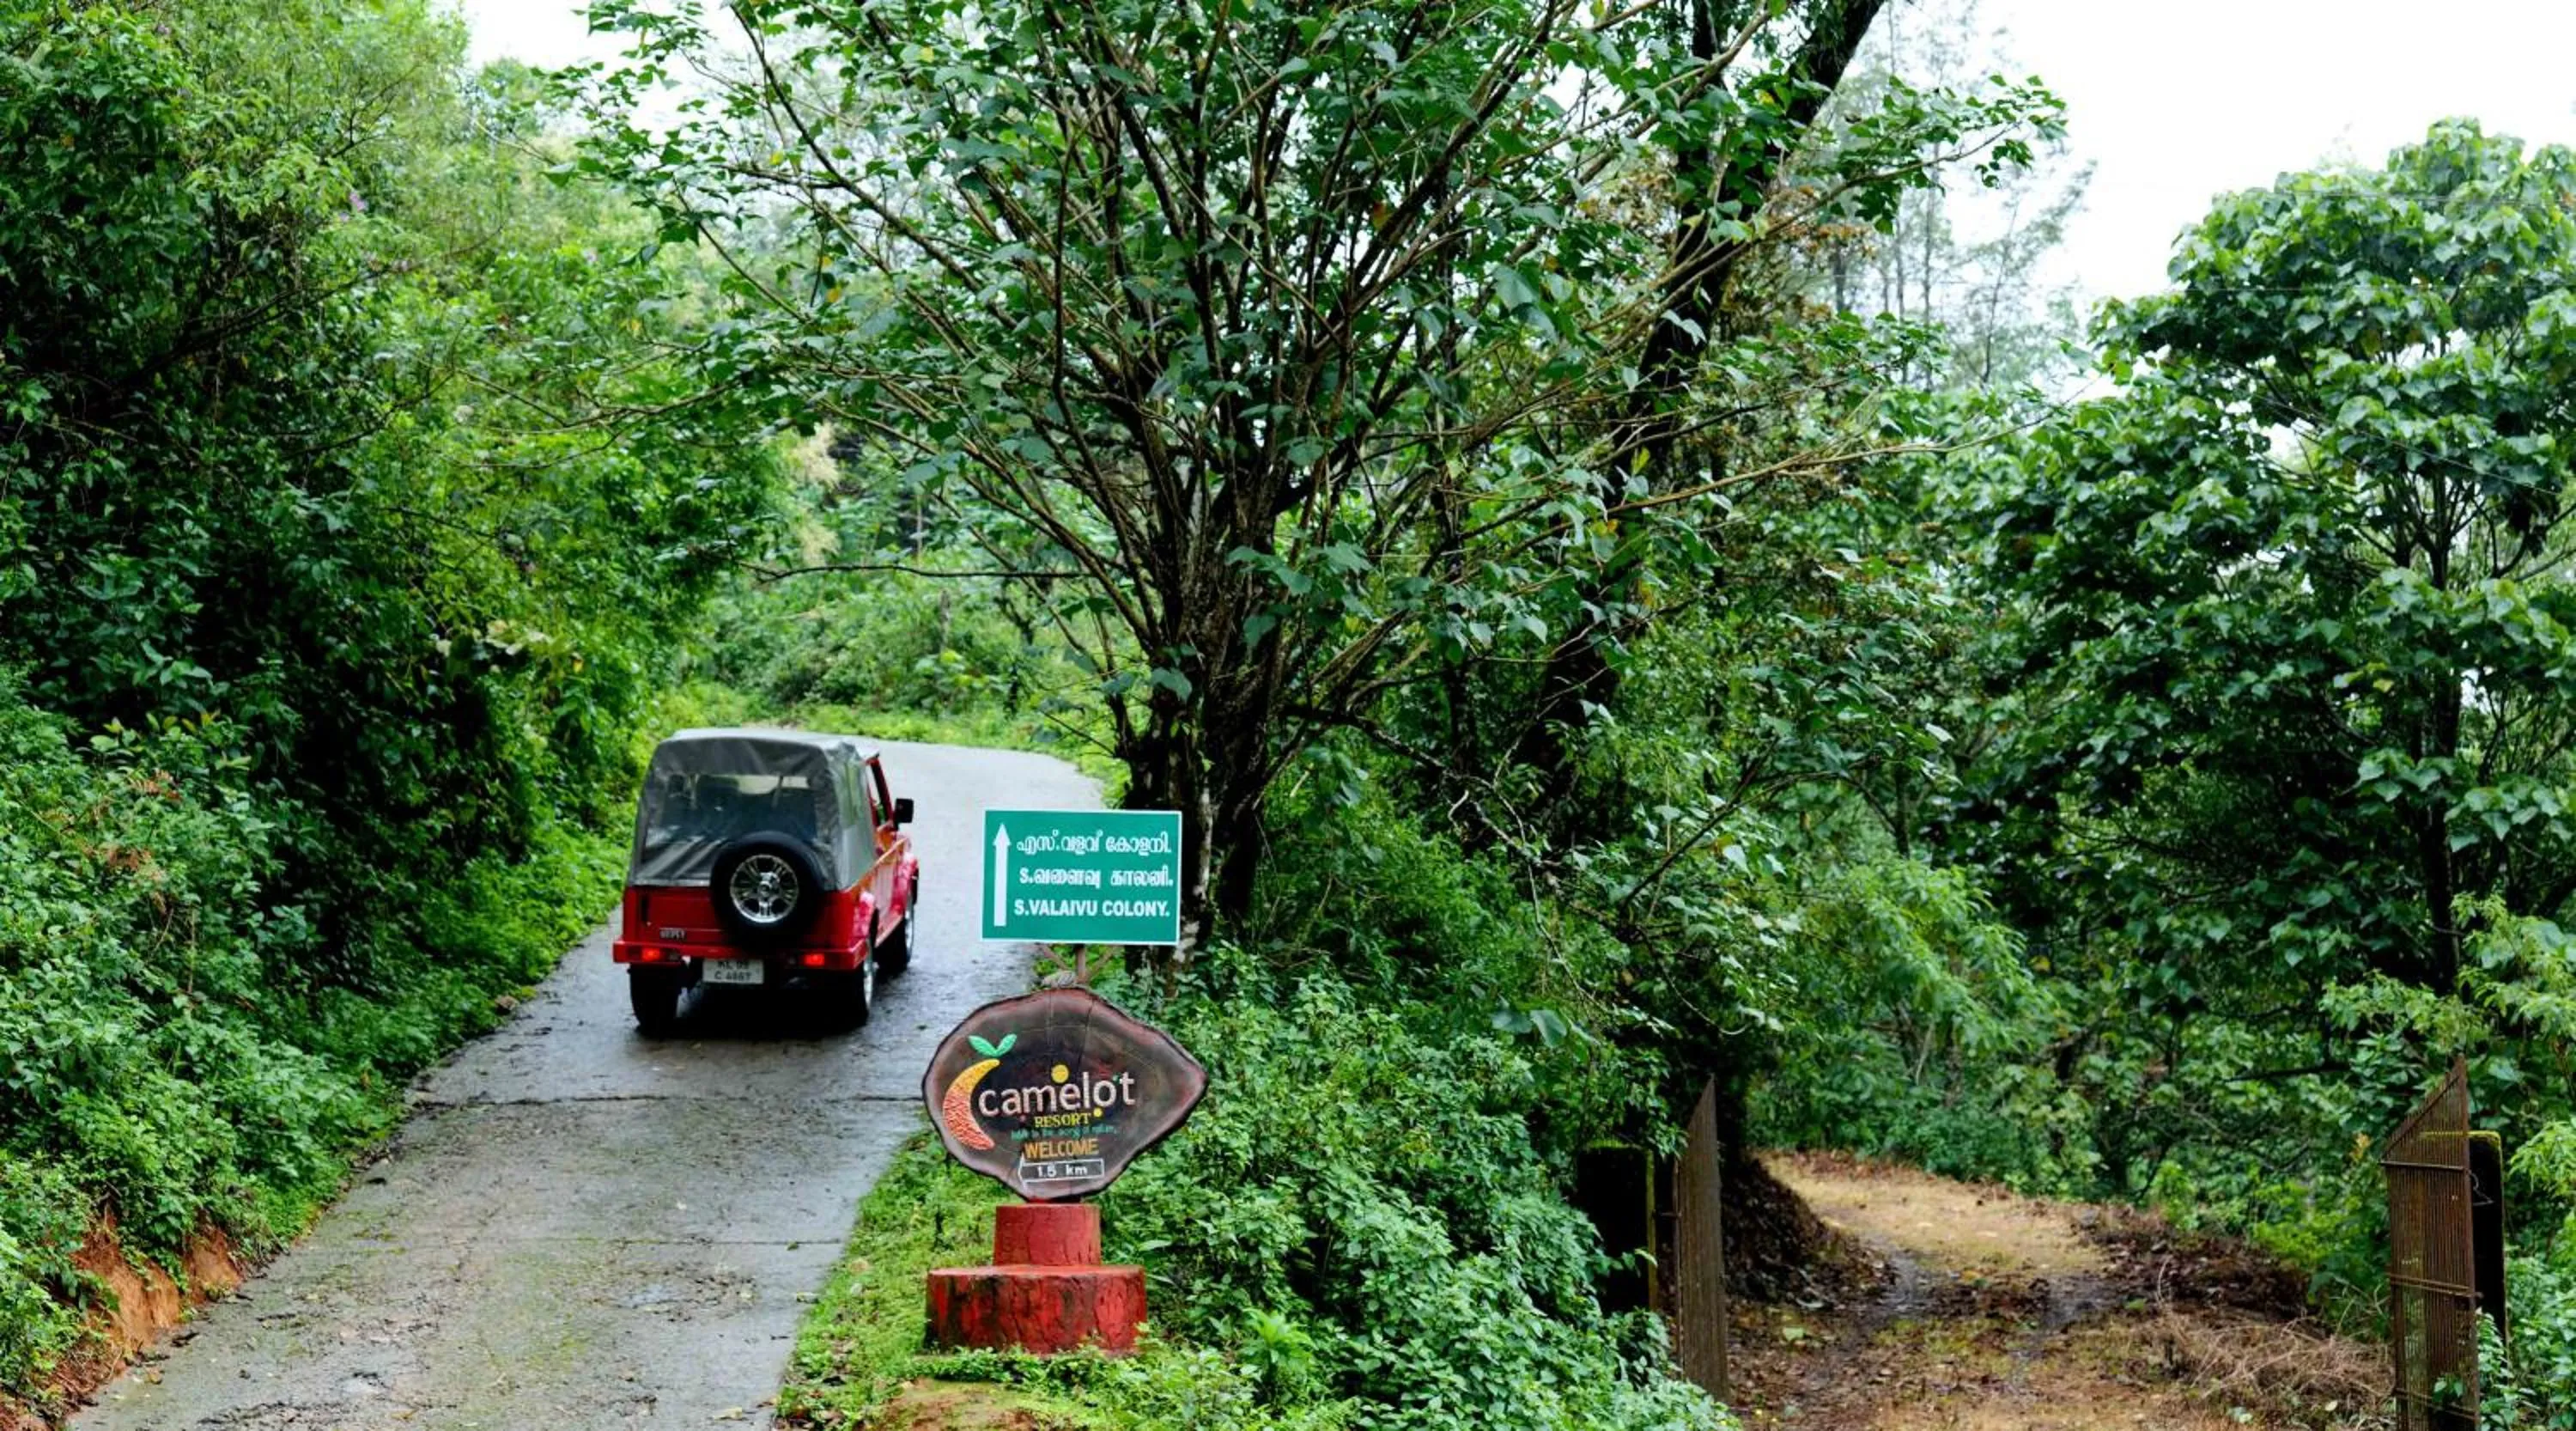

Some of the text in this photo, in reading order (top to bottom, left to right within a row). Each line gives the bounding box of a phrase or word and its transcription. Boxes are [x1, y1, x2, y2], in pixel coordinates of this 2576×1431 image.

[1014, 899, 1170, 917] S.VALAIVU COLONY.
[979, 1071, 1136, 1117] camelot
[1034, 1112, 1091, 1128] RESORT
[1024, 1138, 1099, 1160] WELCOME
[1037, 1162, 1088, 1178] 1.5 km
